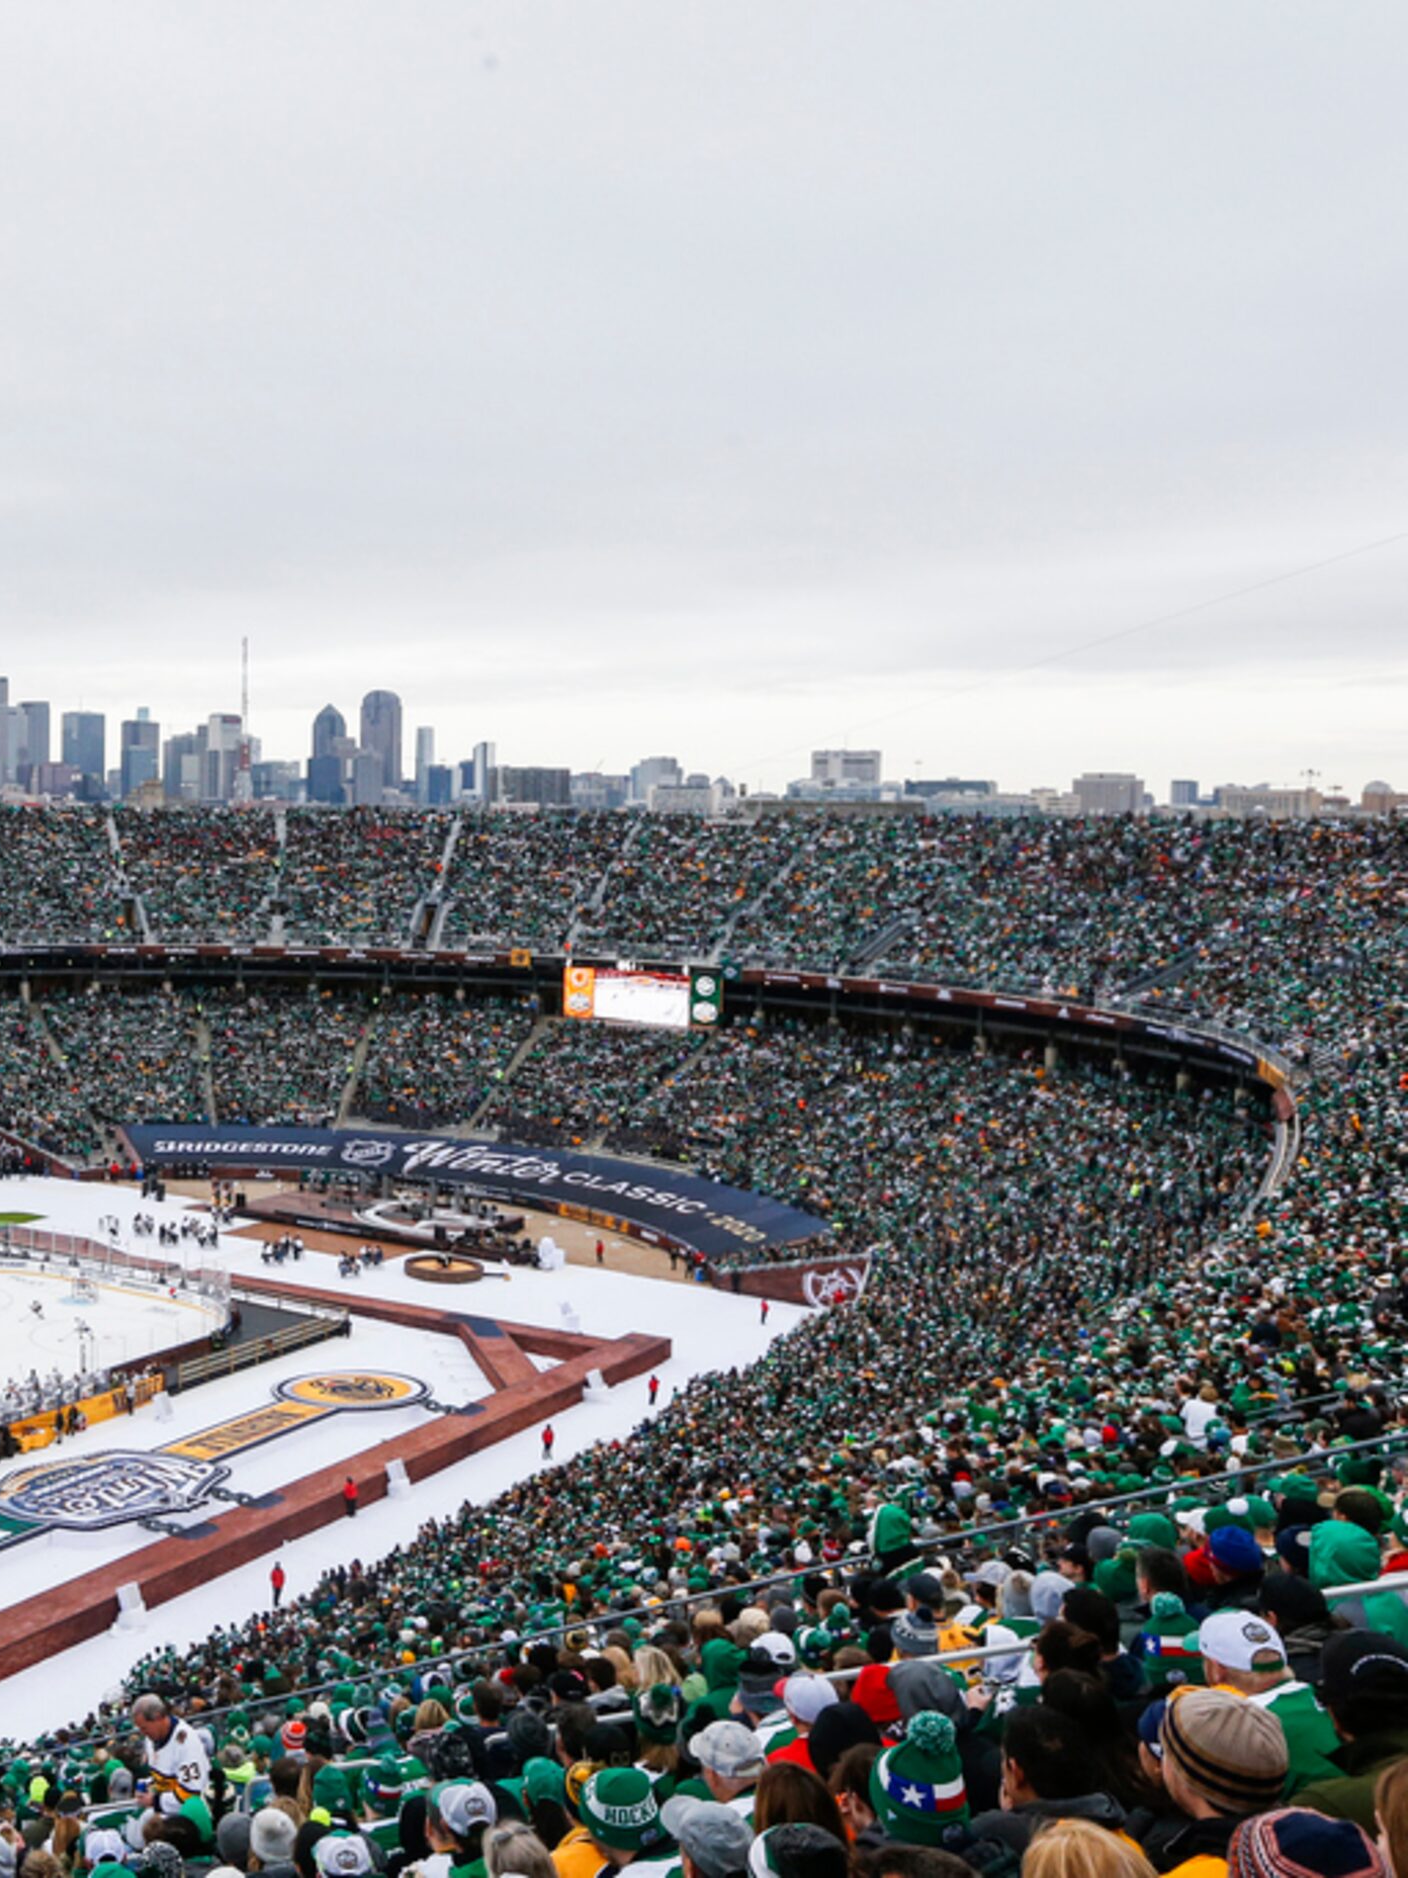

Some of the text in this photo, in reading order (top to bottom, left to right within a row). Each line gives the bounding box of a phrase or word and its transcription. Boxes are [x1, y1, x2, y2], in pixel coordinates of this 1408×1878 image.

[154, 1140, 333, 1157] BRIDGESTONE
[402, 1140, 563, 1184] Winter
[563, 1170, 707, 1215] CLASSIC
[178, 1762, 201, 1783] 33
